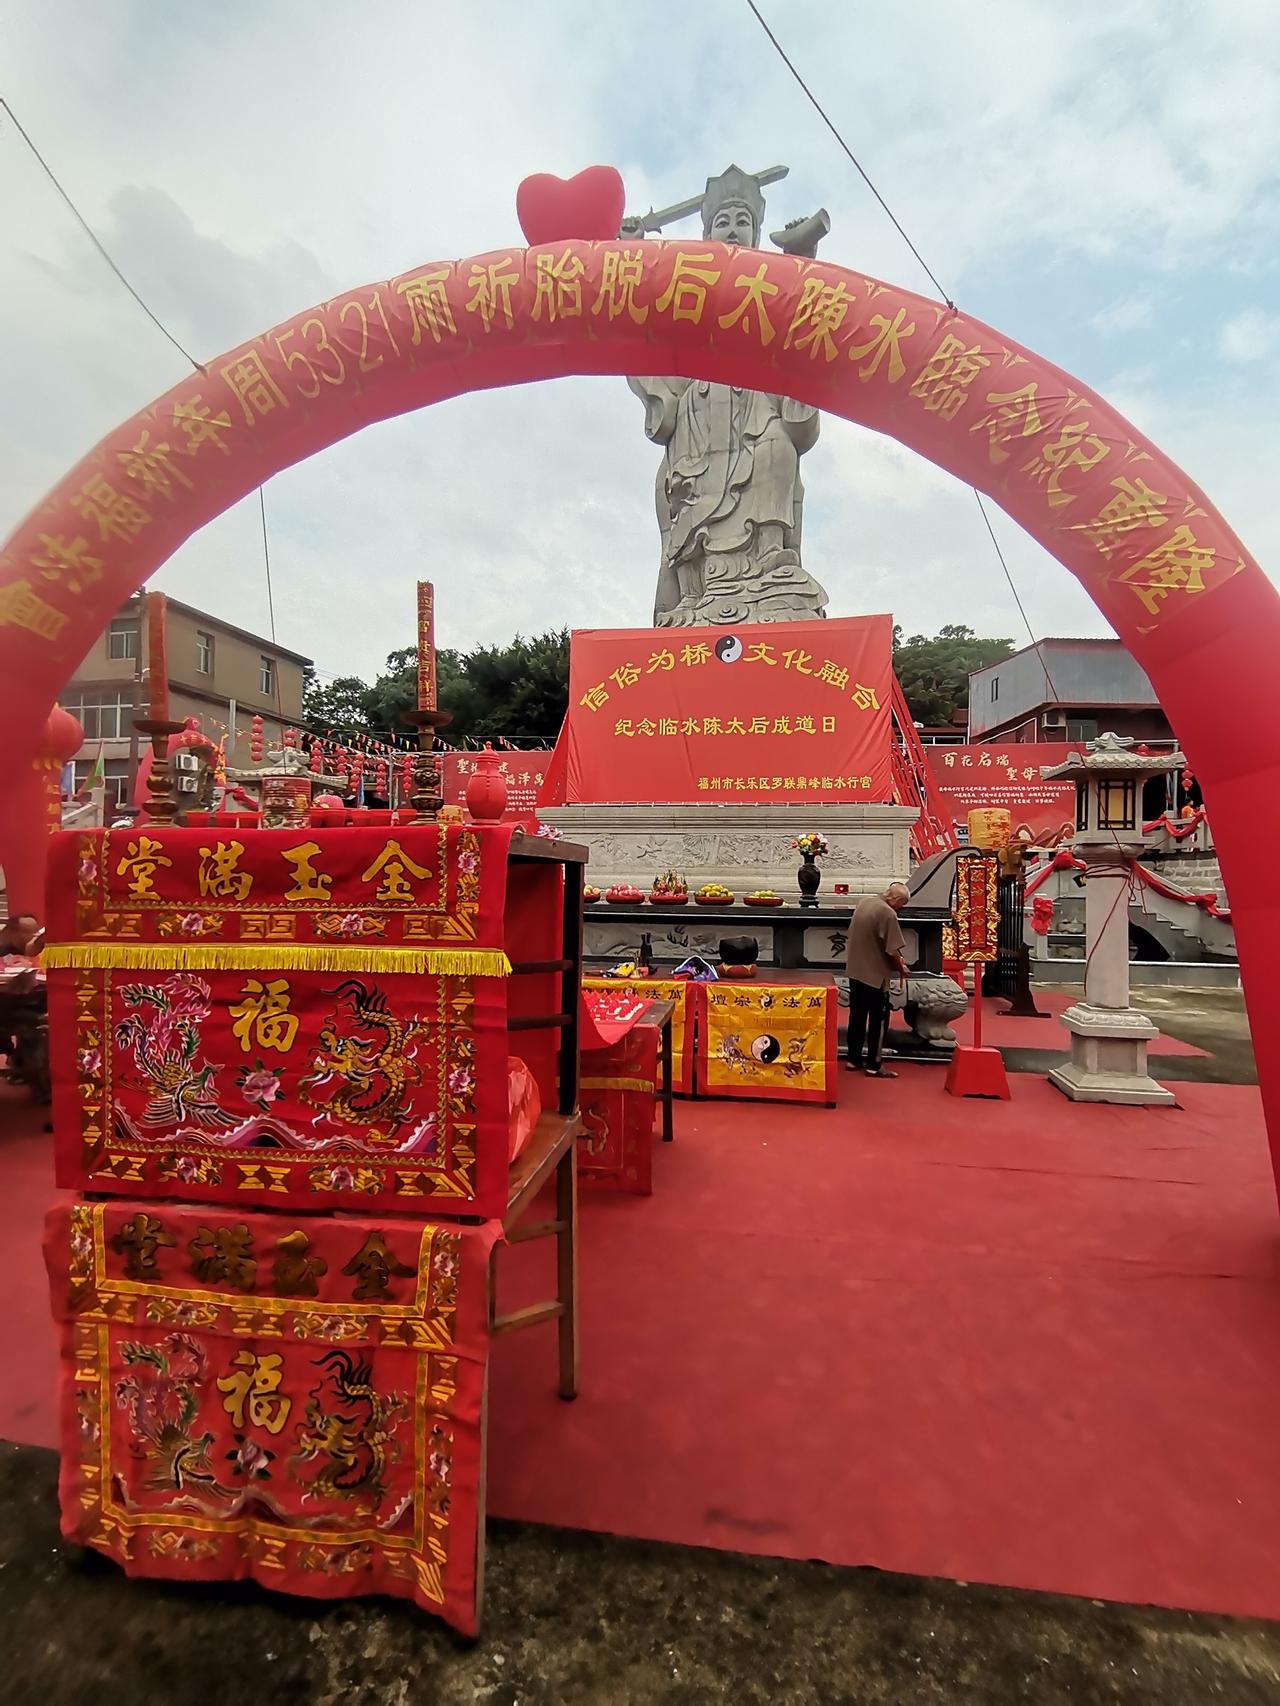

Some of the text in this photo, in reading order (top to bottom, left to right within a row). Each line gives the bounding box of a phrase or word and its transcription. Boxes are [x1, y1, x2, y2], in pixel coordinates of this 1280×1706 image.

[579, 641, 881, 712] 信俗为桥 文化融合
[613, 715, 837, 738] 纪念临水陈太后成道日
[229, 978, 300, 1053] 福
[216, 1350, 291, 1434] 福
